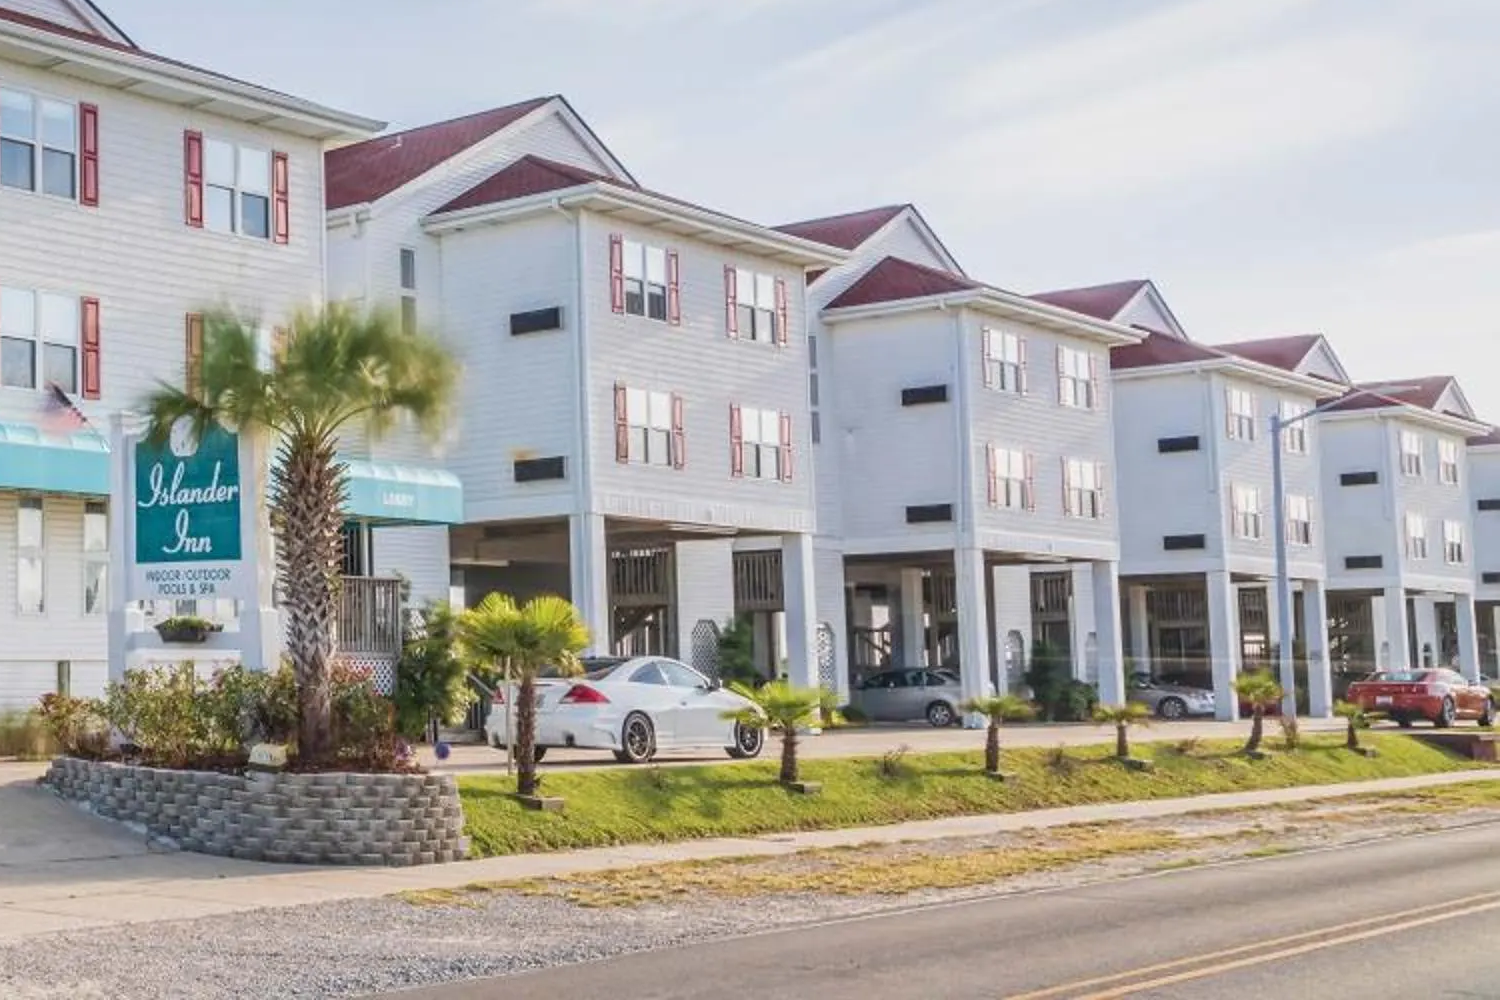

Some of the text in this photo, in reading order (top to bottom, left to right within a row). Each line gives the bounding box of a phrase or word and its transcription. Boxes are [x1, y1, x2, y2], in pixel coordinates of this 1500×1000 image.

[138, 461, 239, 507] Islander
[162, 508, 212, 553] Inn
[158, 583, 215, 595] POOLS & SPA
